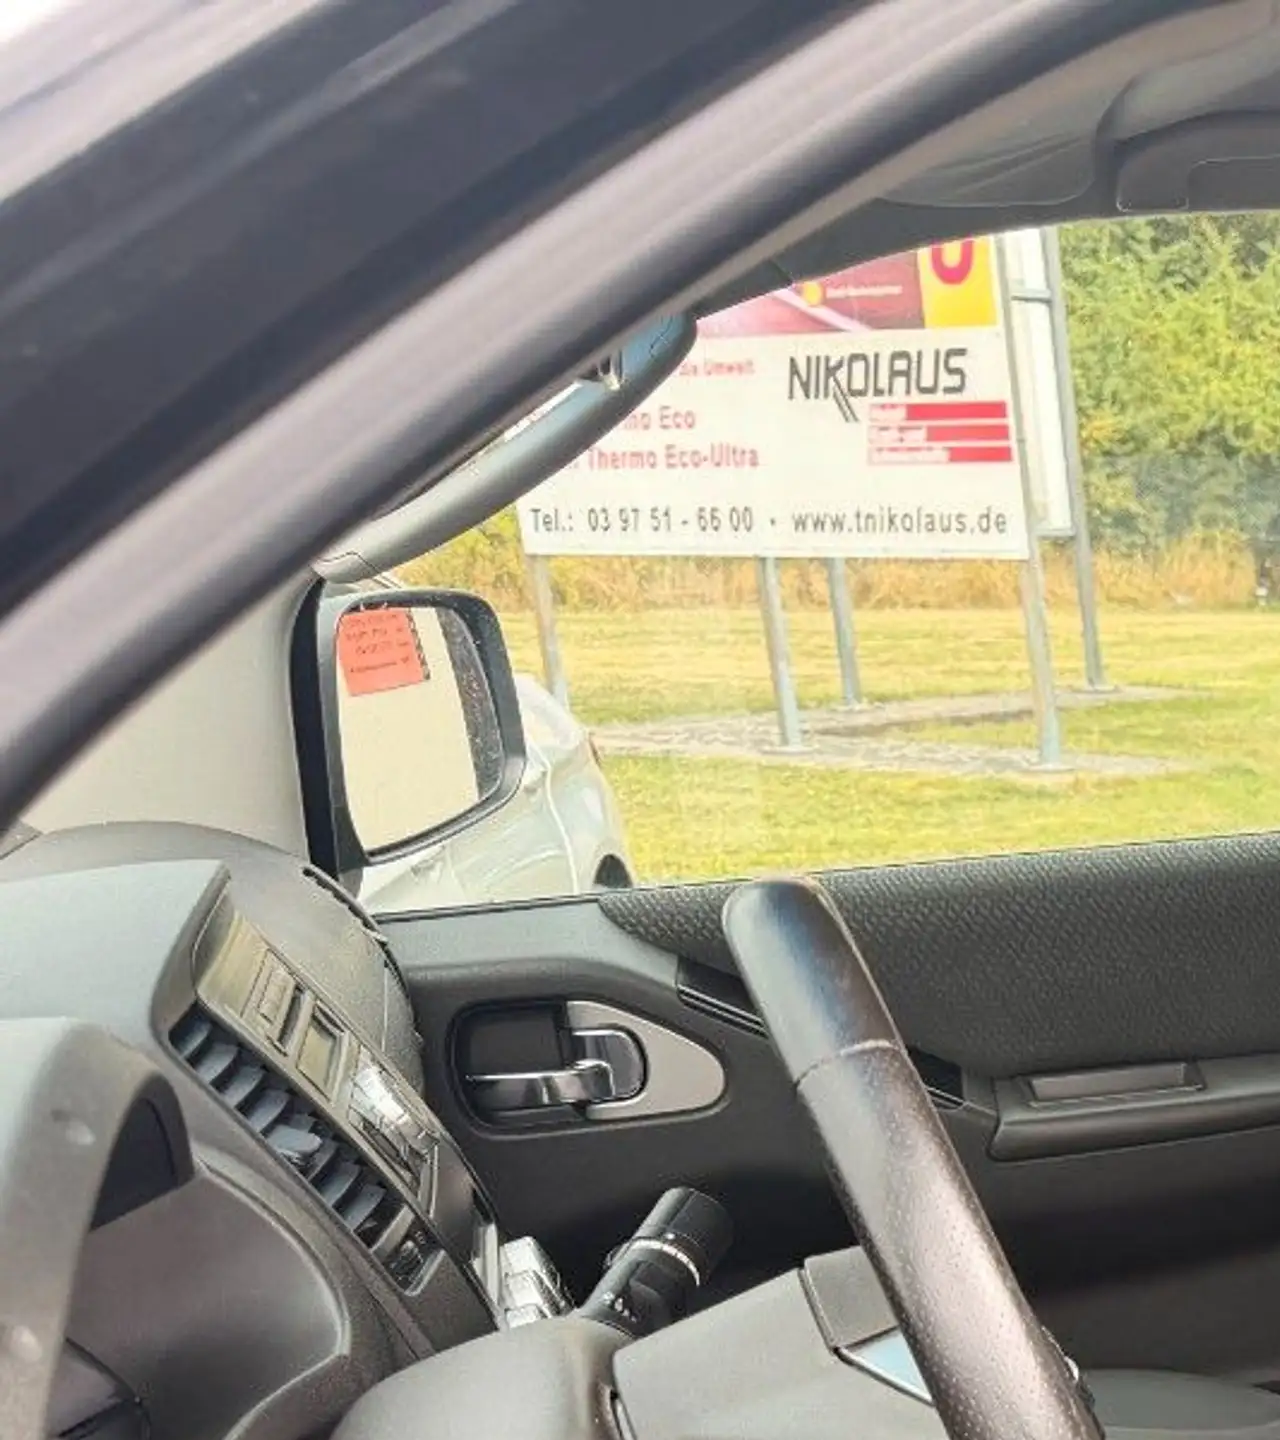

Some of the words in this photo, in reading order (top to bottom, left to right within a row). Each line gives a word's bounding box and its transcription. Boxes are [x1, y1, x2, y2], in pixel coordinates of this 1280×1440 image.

[788, 348, 968, 422] NIKOLAUS
[659, 405, 696, 431] Eco
[588, 447, 658, 470] Thermo
[664, 443, 760, 469] Eco-Ultra
[530, 507, 574, 532] Tel.:
[587, 507, 610, 532] 03
[618, 507, 640, 532] 97
[650, 507, 671, 532] 51
[697, 506, 722, 532] 66
[729, 505, 754, 532] 00
[791, 506, 1008, 535] www.tnikolaus.de
